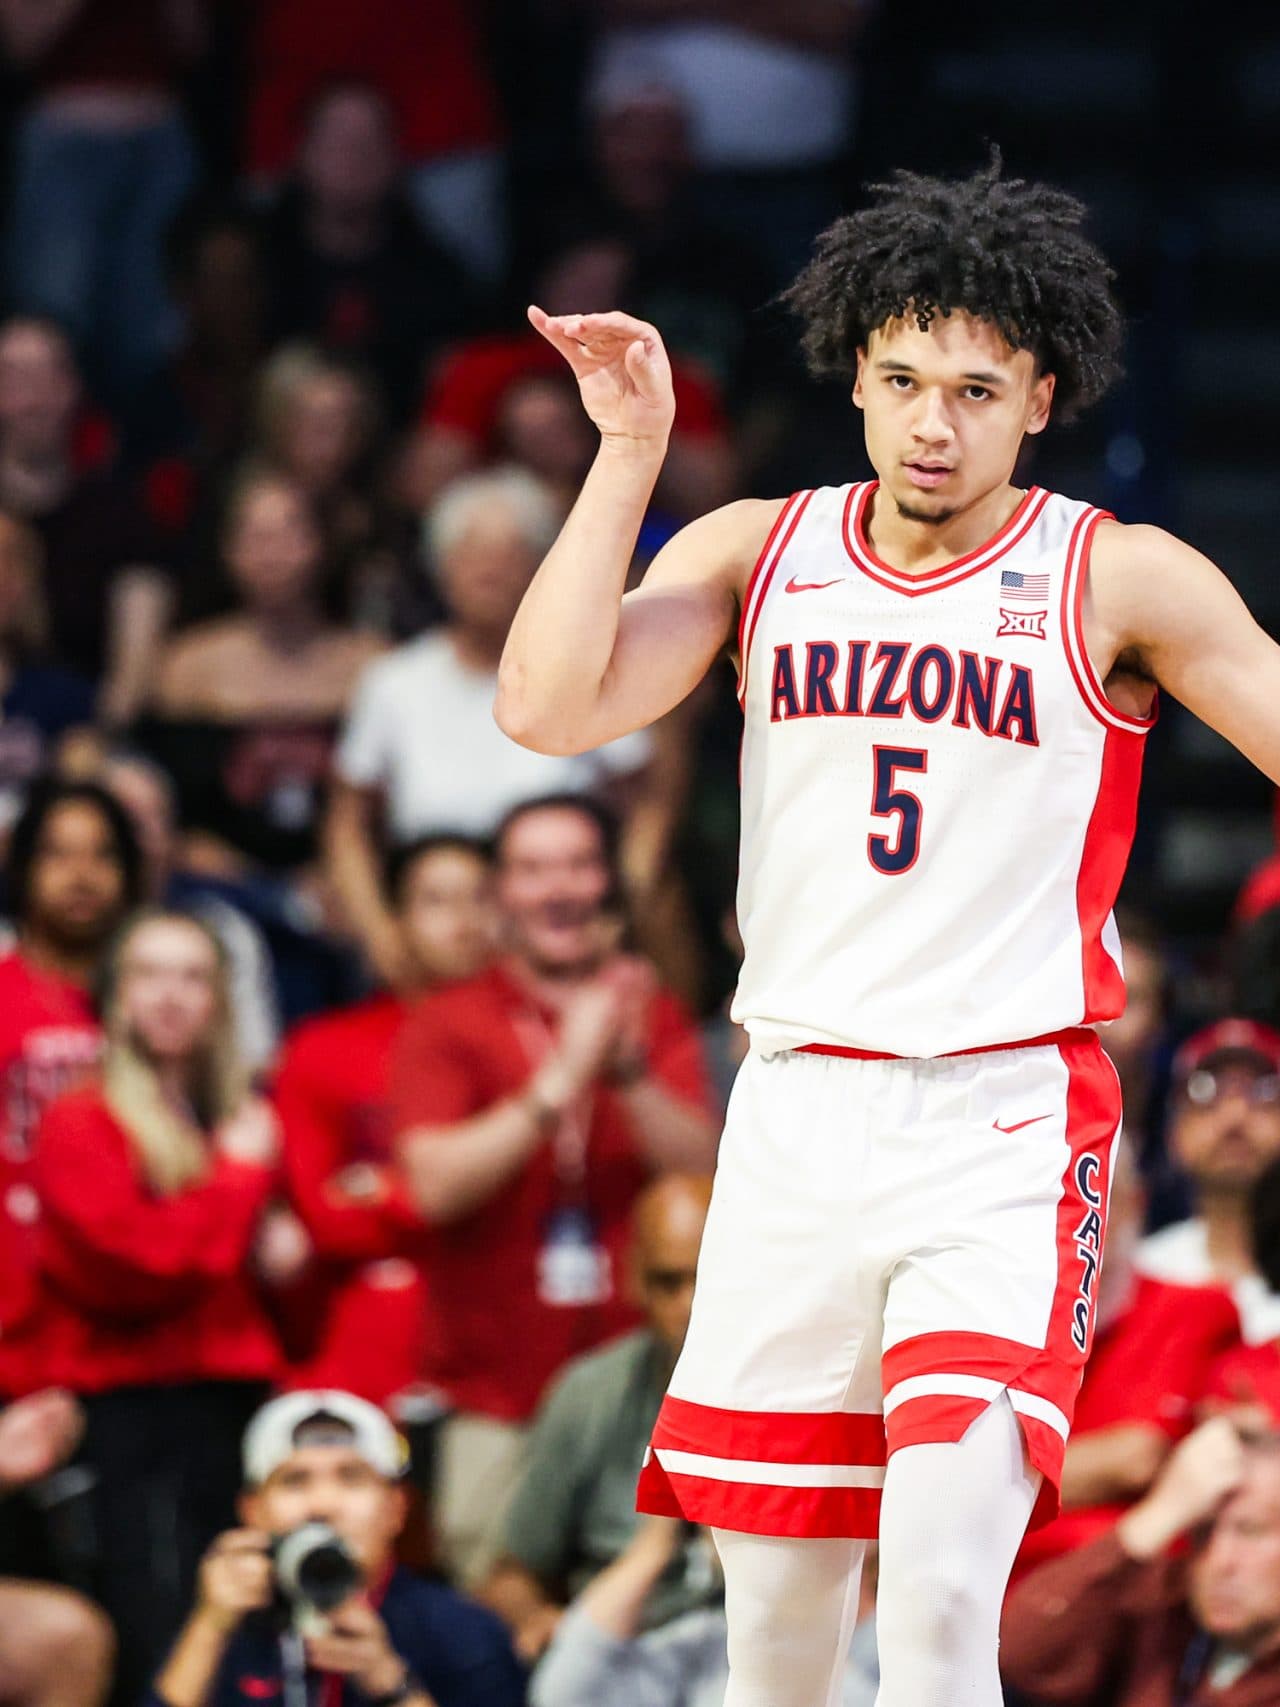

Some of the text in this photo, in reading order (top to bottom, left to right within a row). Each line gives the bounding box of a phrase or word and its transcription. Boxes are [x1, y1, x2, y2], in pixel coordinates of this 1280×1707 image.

[770, 640, 1040, 747] ARIZONA
[866, 744, 928, 875] 5
[1071, 1152, 1102, 1354] CATS
